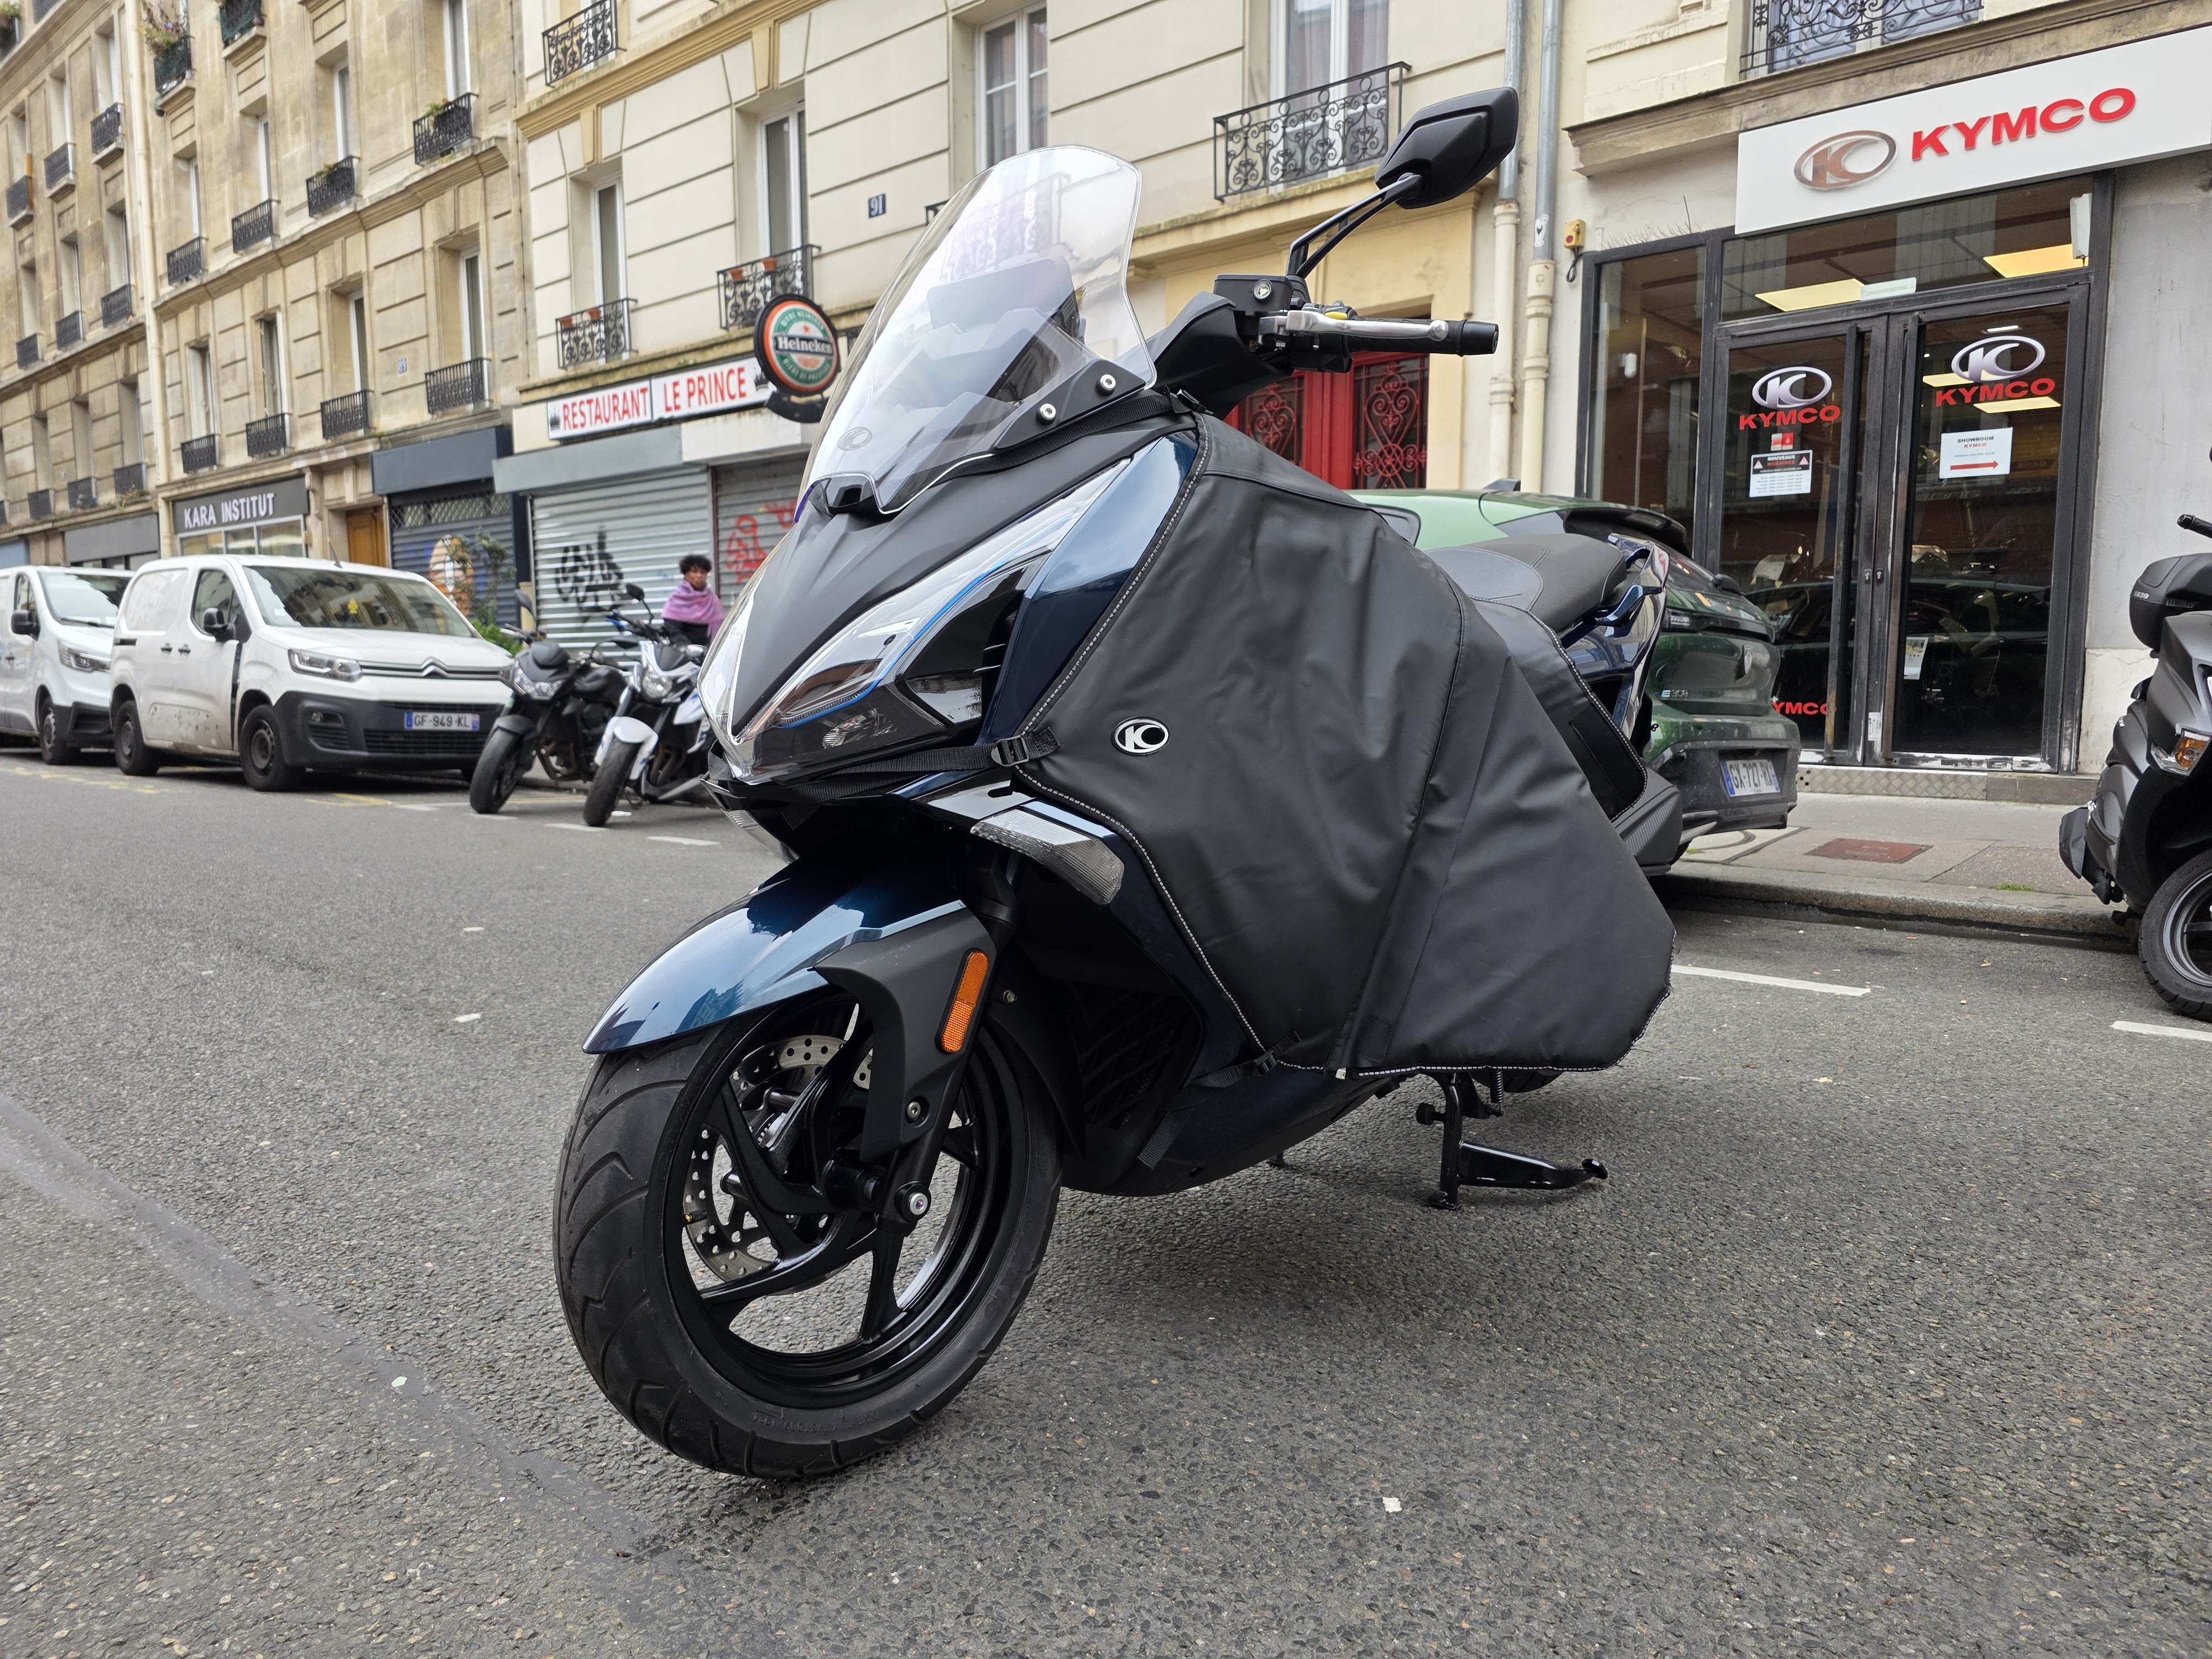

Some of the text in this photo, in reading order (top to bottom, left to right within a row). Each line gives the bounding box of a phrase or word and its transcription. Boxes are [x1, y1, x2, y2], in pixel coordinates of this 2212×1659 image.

[1912, 87, 2136, 161] KYMCO
[870, 196, 884, 216] 91
[778, 336, 832, 354] Heineken
[399, 358, 406, 372] 89
[562, 387, 649, 431] RESTAURANT
[664, 380, 682, 413] LE
[687, 367, 747, 409] PRINCE
[1936, 378, 2056, 406] KYMCO
[1739, 405, 1840, 430] KYMCO
[184, 493, 274, 529] KARA INSTITUT
